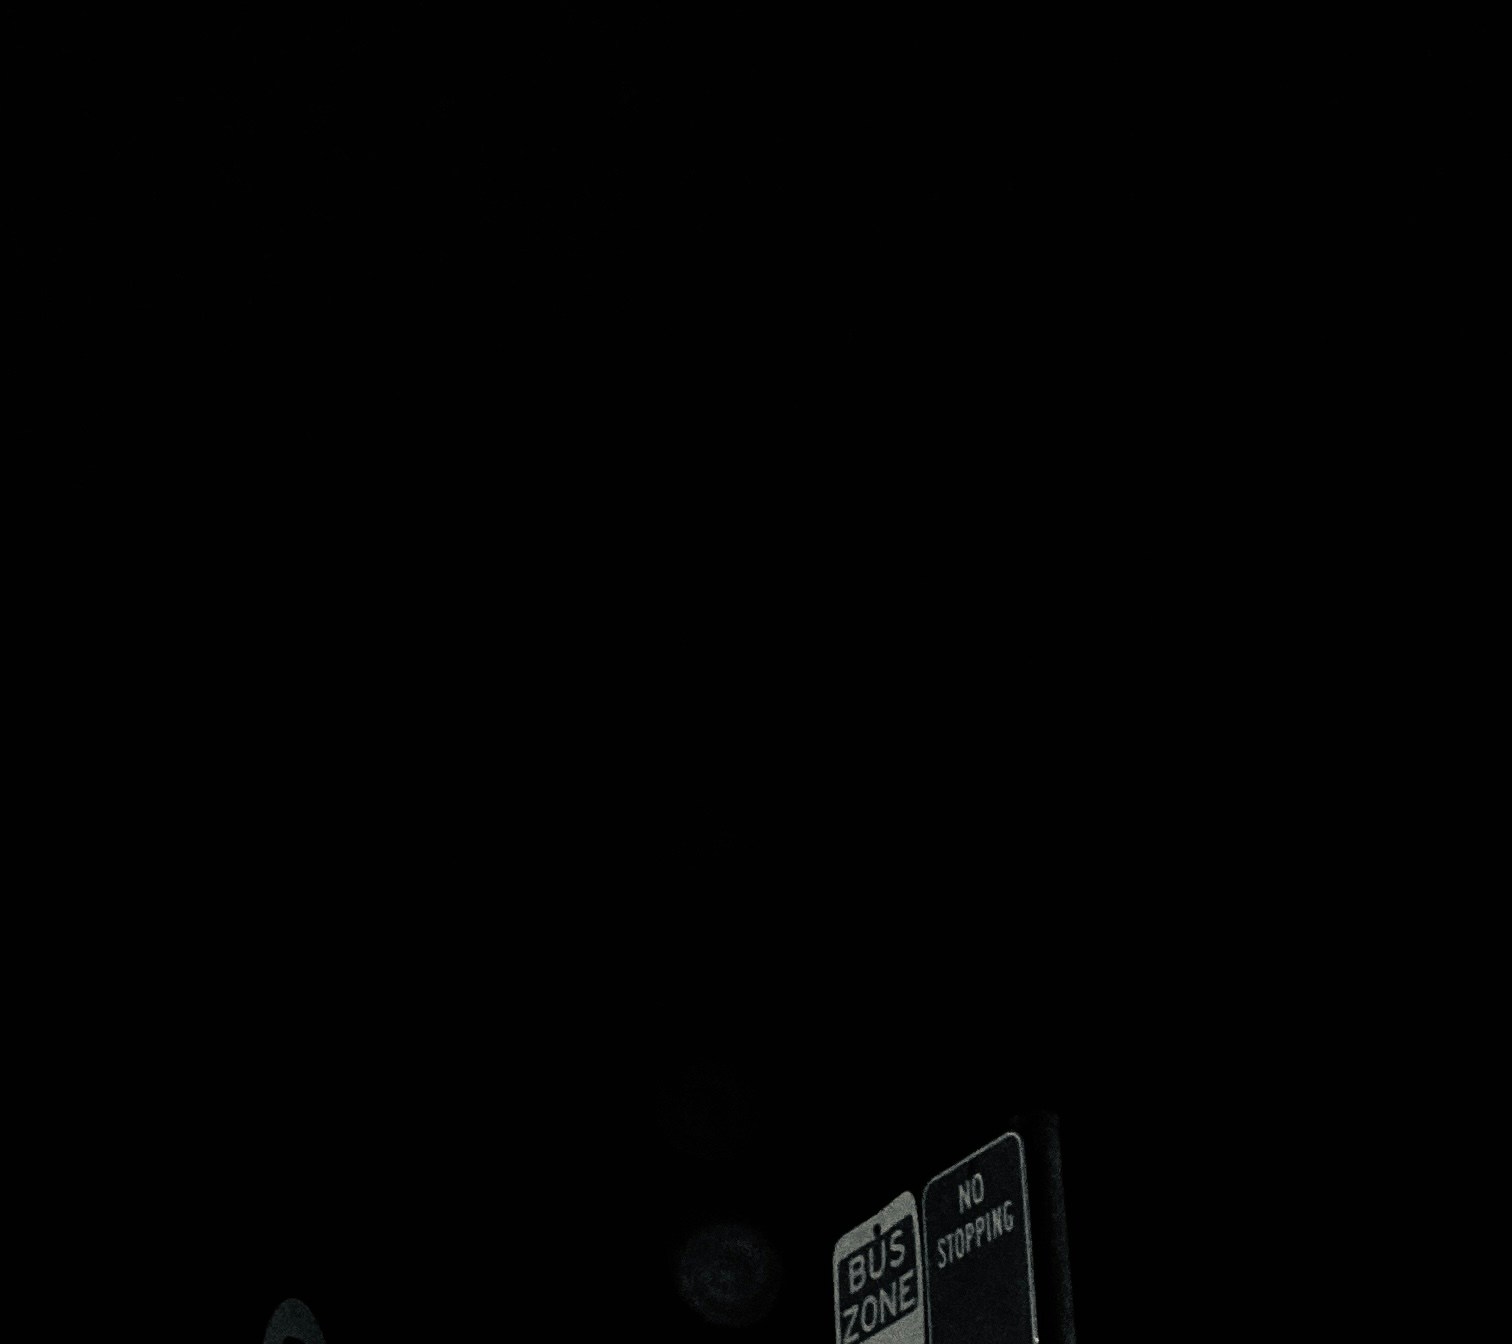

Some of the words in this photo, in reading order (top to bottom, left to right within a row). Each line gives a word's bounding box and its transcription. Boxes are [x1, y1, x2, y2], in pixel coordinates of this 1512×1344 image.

[957, 1172, 985, 1214] NO
[847, 1228, 907, 1295] BUS
[937, 1200, 1015, 1270] STOPPING
[841, 1268, 918, 1344] ZONE
